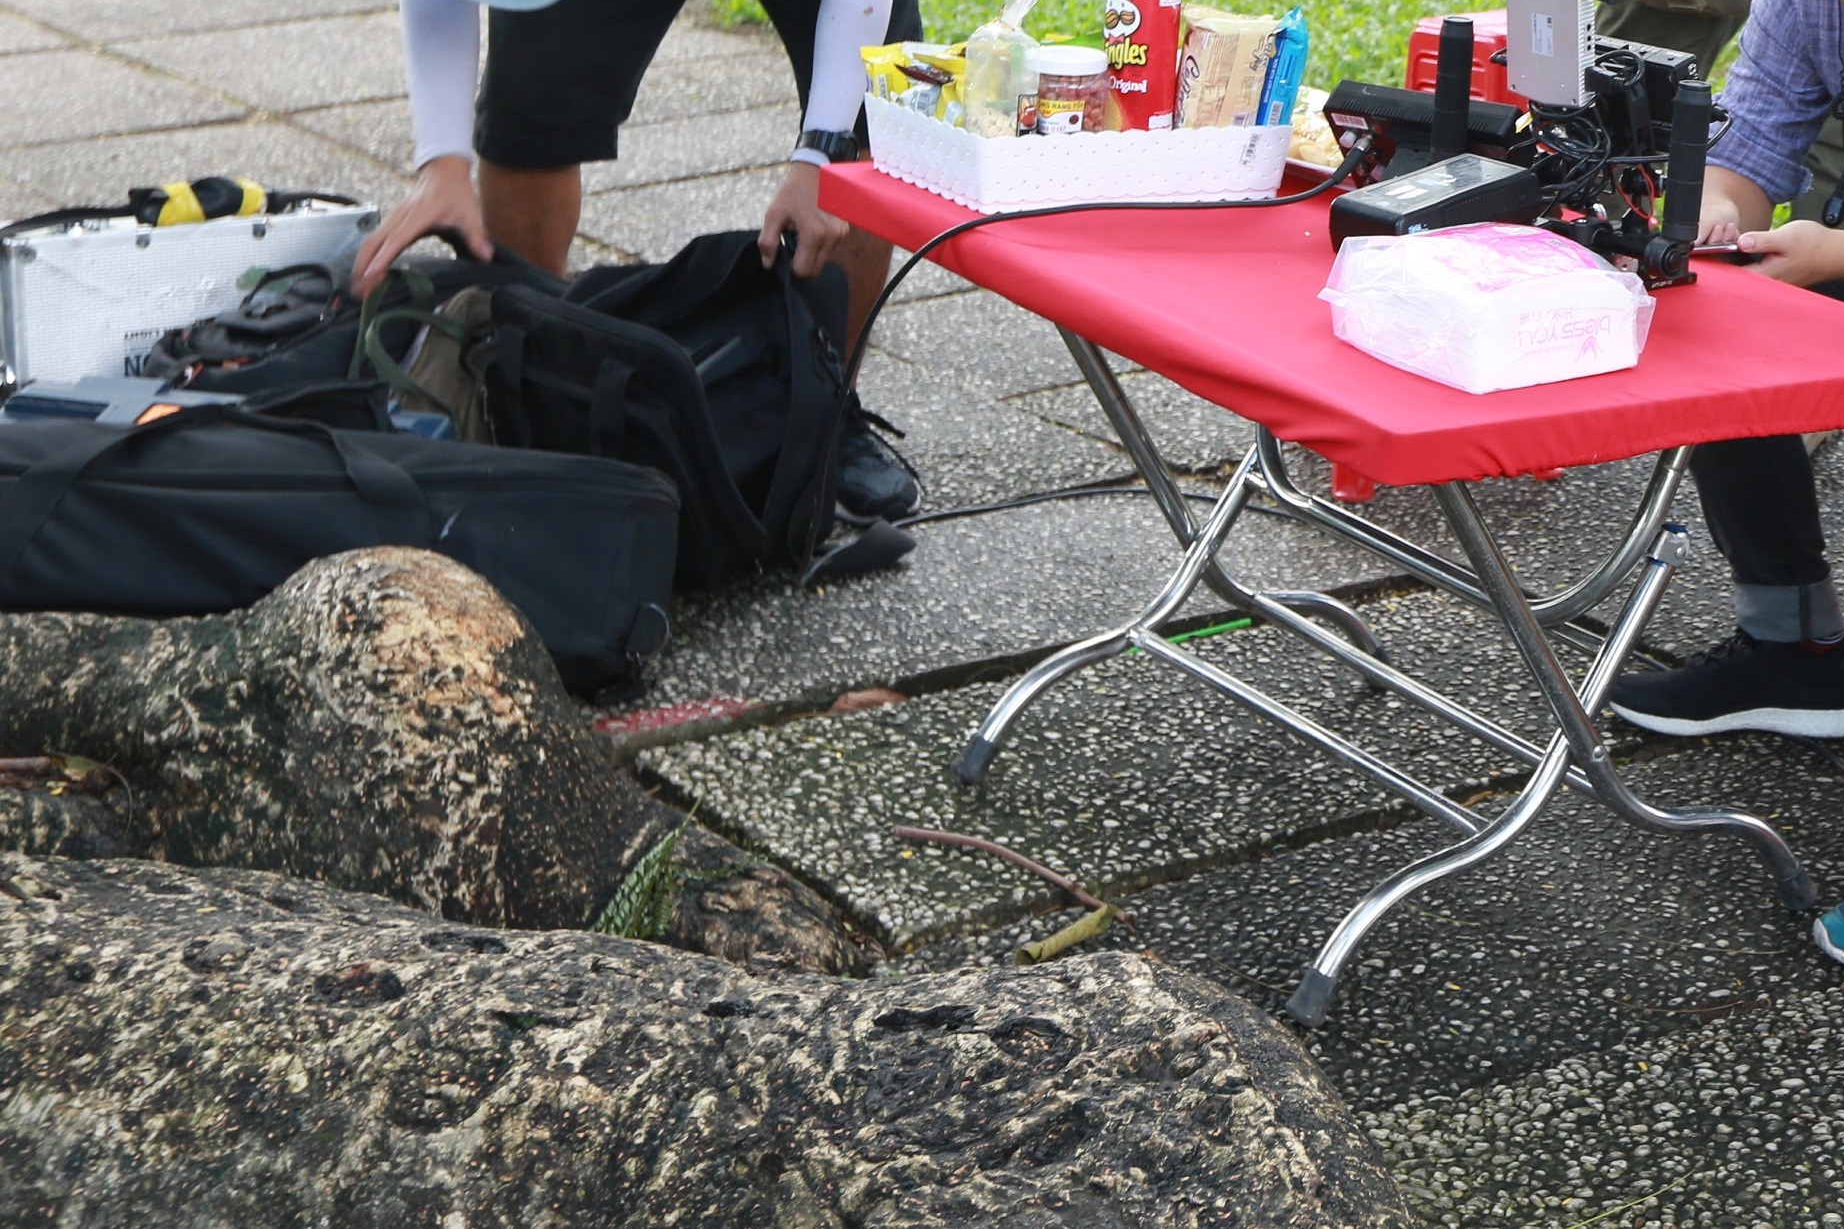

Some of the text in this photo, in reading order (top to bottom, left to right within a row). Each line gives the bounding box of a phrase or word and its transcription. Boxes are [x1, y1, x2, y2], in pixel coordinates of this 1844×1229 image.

[1104, 37, 1148, 70] ingles
[1109, 75, 1148, 94] Original
[1561, 314, 1611, 340] bless
